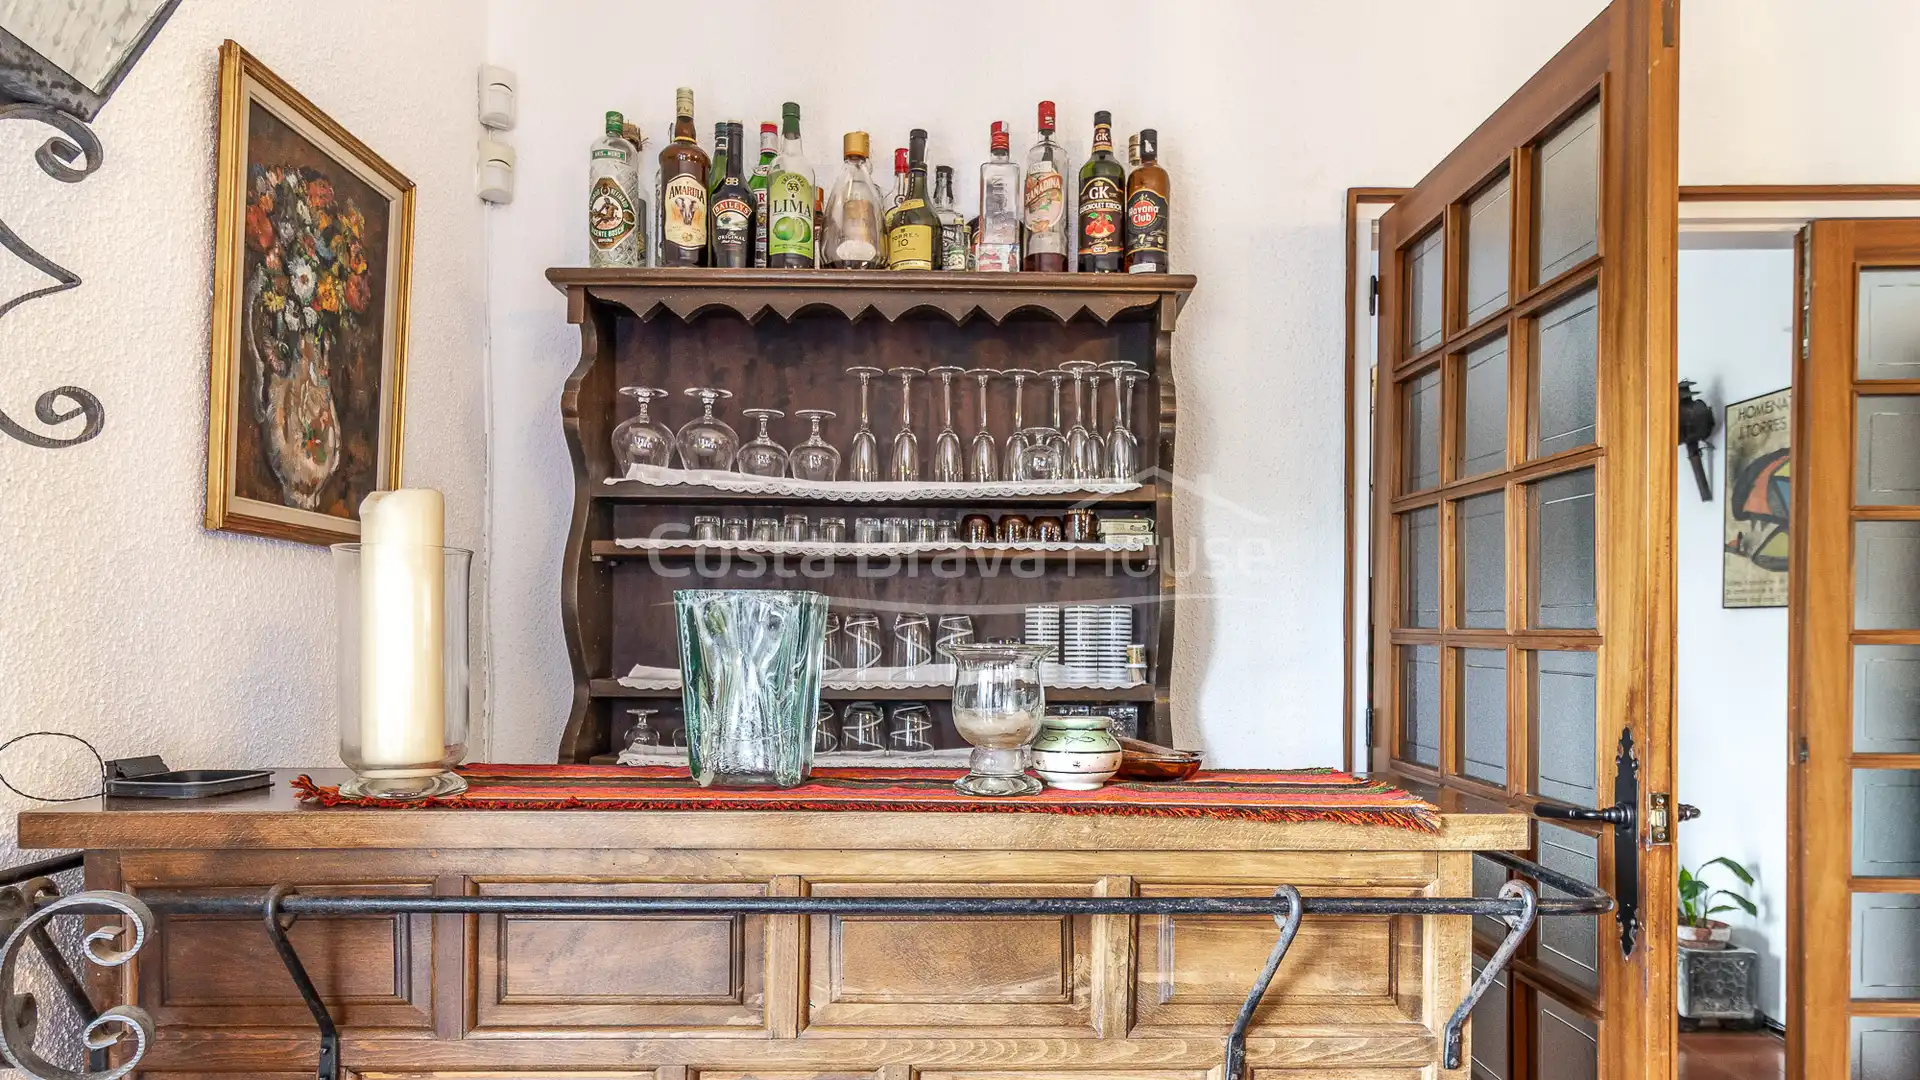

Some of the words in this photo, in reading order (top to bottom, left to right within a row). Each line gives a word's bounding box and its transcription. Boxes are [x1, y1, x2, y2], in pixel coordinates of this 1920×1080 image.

[1095, 132, 1109, 142] GK
[787, 182, 799, 191] 33
[669, 185, 705, 205] AMARULA
[1088, 186, 1110, 200] GK
[715, 201, 749, 214] BAILEYS
[773, 199, 812, 218] LIMA
[1128, 203, 1160, 216] Havana
[1133, 211, 1152, 223] Club
[892, 232, 920, 243] TORRES
[898, 238, 909, 248] 10
[1138, 233, 1146, 244] 7
